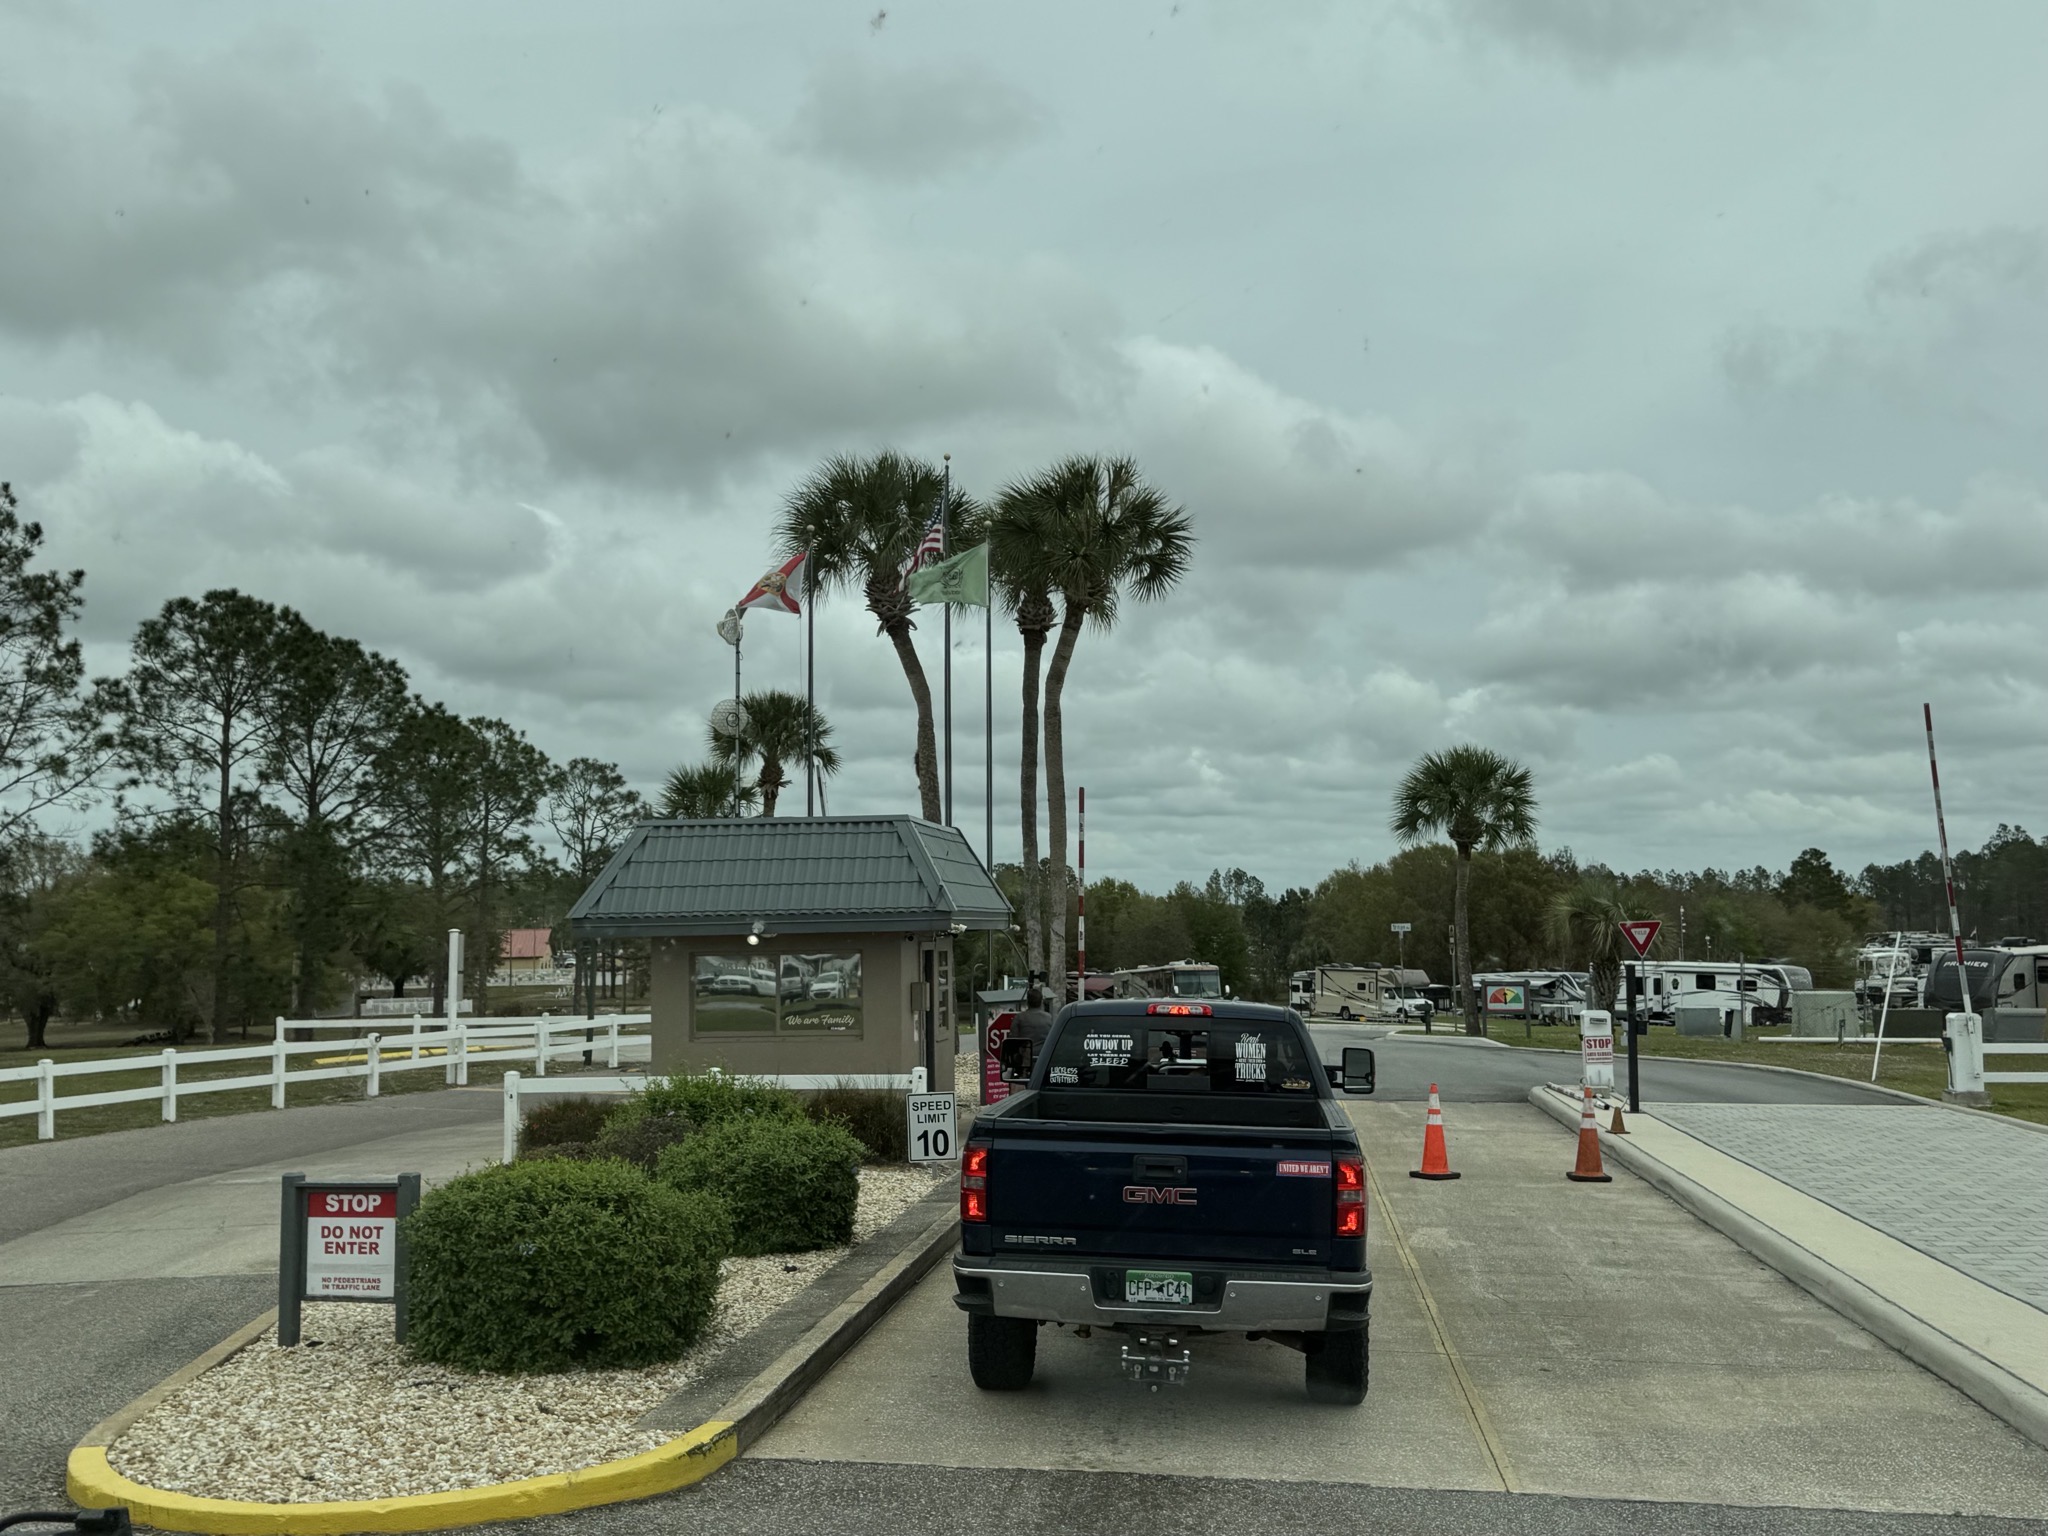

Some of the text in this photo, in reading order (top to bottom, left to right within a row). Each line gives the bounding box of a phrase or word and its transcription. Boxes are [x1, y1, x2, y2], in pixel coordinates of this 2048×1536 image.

[786, 1015, 802, 1025] We
[821, 1014, 855, 1026] Family
[990, 1029, 1010, 1049] ST
[1240, 1032, 1261, 1043] Real
[1586, 1038, 1611, 1049] STOP
[1084, 1039, 1133, 1050] COWBOY UP
[1235, 1042, 1266, 1058] WOMEN
[1235, 1063, 1266, 1079] TRUCKS
[912, 1101, 951, 1111] SPEED
[917, 1113, 947, 1123] LIMIT
[917, 1129, 949, 1156] 10
[1279, 1164, 1299, 1172] UNITED
[1300, 1164, 1308, 1173] WE
[1122, 1186, 1197, 1206] GMC
[325, 1194, 382, 1212] STOP
[321, 1226, 384, 1239] DO NOT
[1004, 1235, 1076, 1245] SIERRA
[324, 1242, 380, 1255] ENTER
[1129, 1280, 1189, 1298] CFP C41
